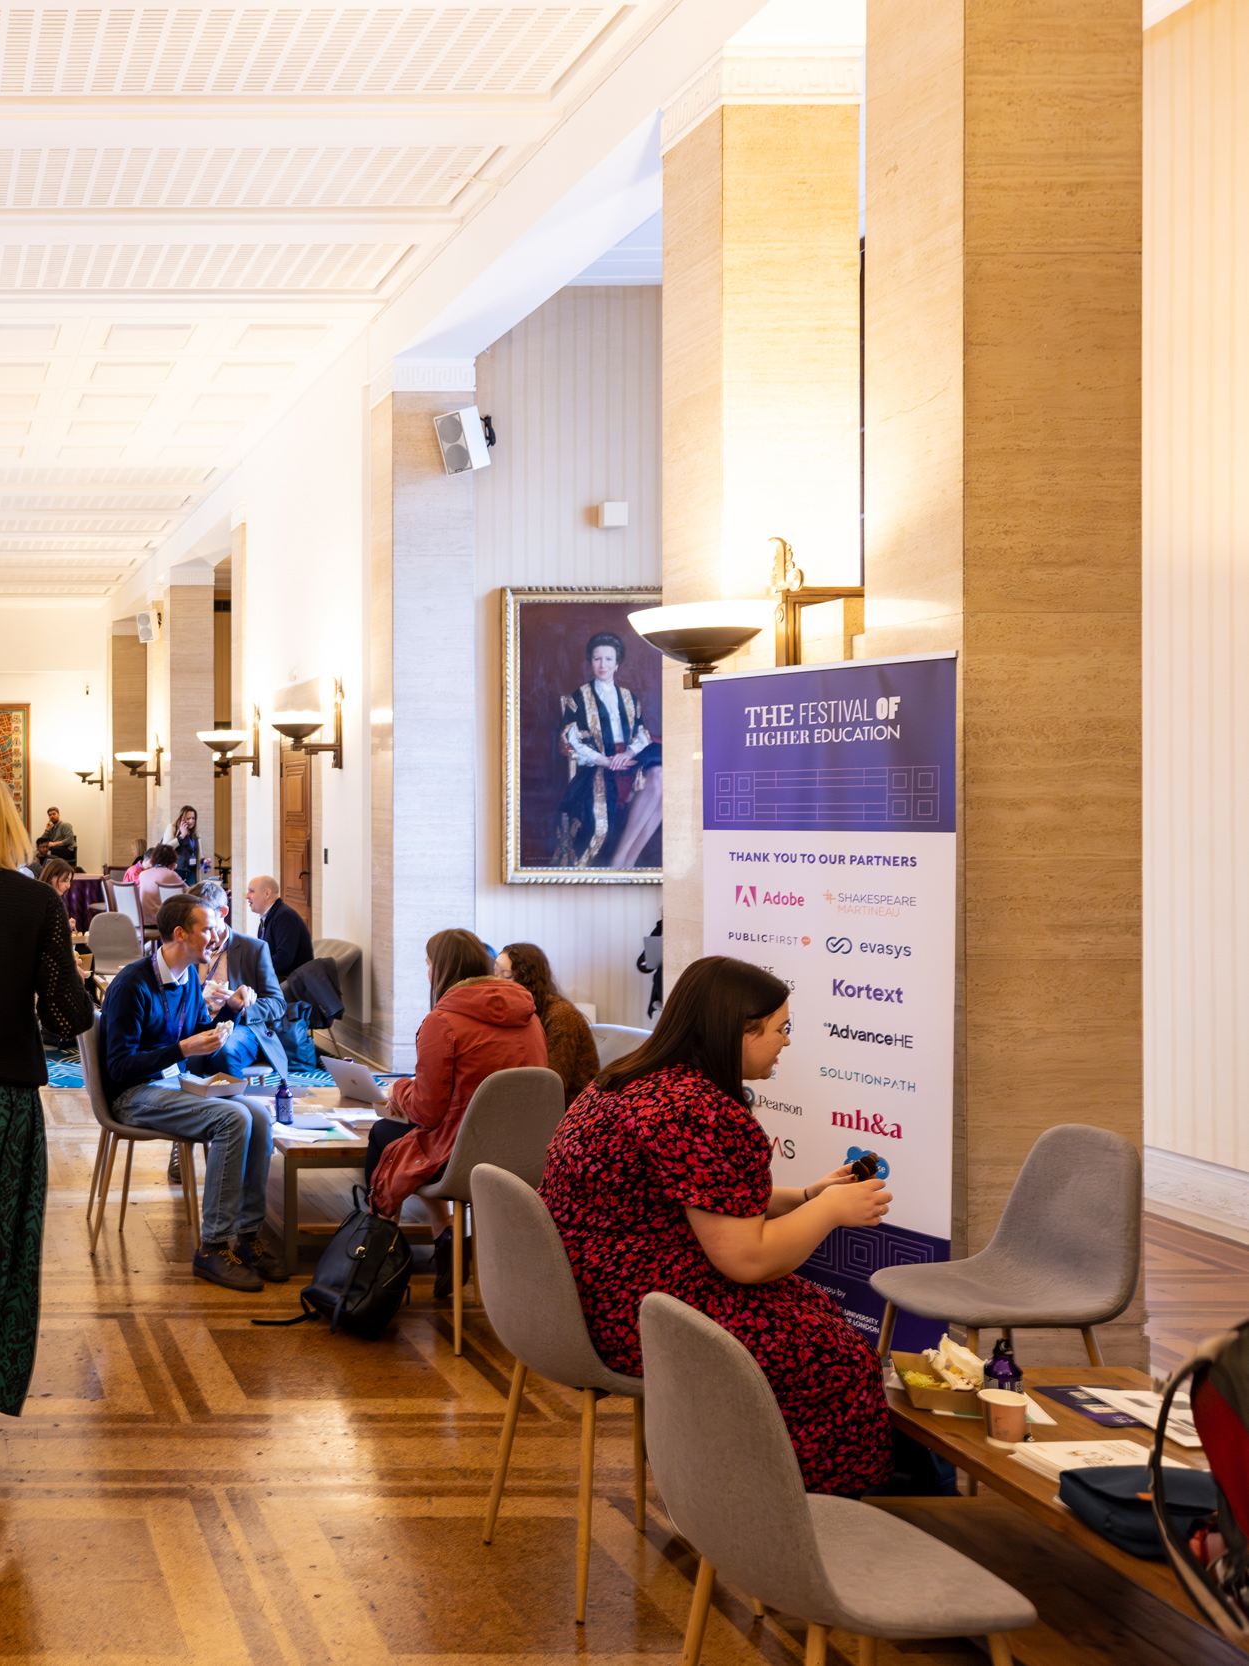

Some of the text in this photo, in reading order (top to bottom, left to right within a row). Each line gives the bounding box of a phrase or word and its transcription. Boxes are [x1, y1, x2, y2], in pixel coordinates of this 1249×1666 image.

[744, 695, 901, 729] THE FESTIVAL OF
[745, 724, 900, 747] HIGHER EDUCATION
[729, 852, 917, 867] THANK YOU TO OUR PARTNERS
[762, 891, 805, 907] Adobe
[838, 892, 917, 907] SHAKESPEARE
[837, 904, 900, 917] MARTINEAU
[728, 931, 798, 945] PUBLICFIRST
[859, 941, 912, 959] evasys
[832, 978, 903, 1004] Kortext
[819, 1066, 916, 1092] SOLUTIONPATH
[758, 1094, 803, 1116] Pearson
[831, 1109, 903, 1139] mh&a
[837, 1287, 847, 1299] by
[844, 1309, 879, 1325] UNIVERSITY
[853, 1320, 881, 1334] LONDON
